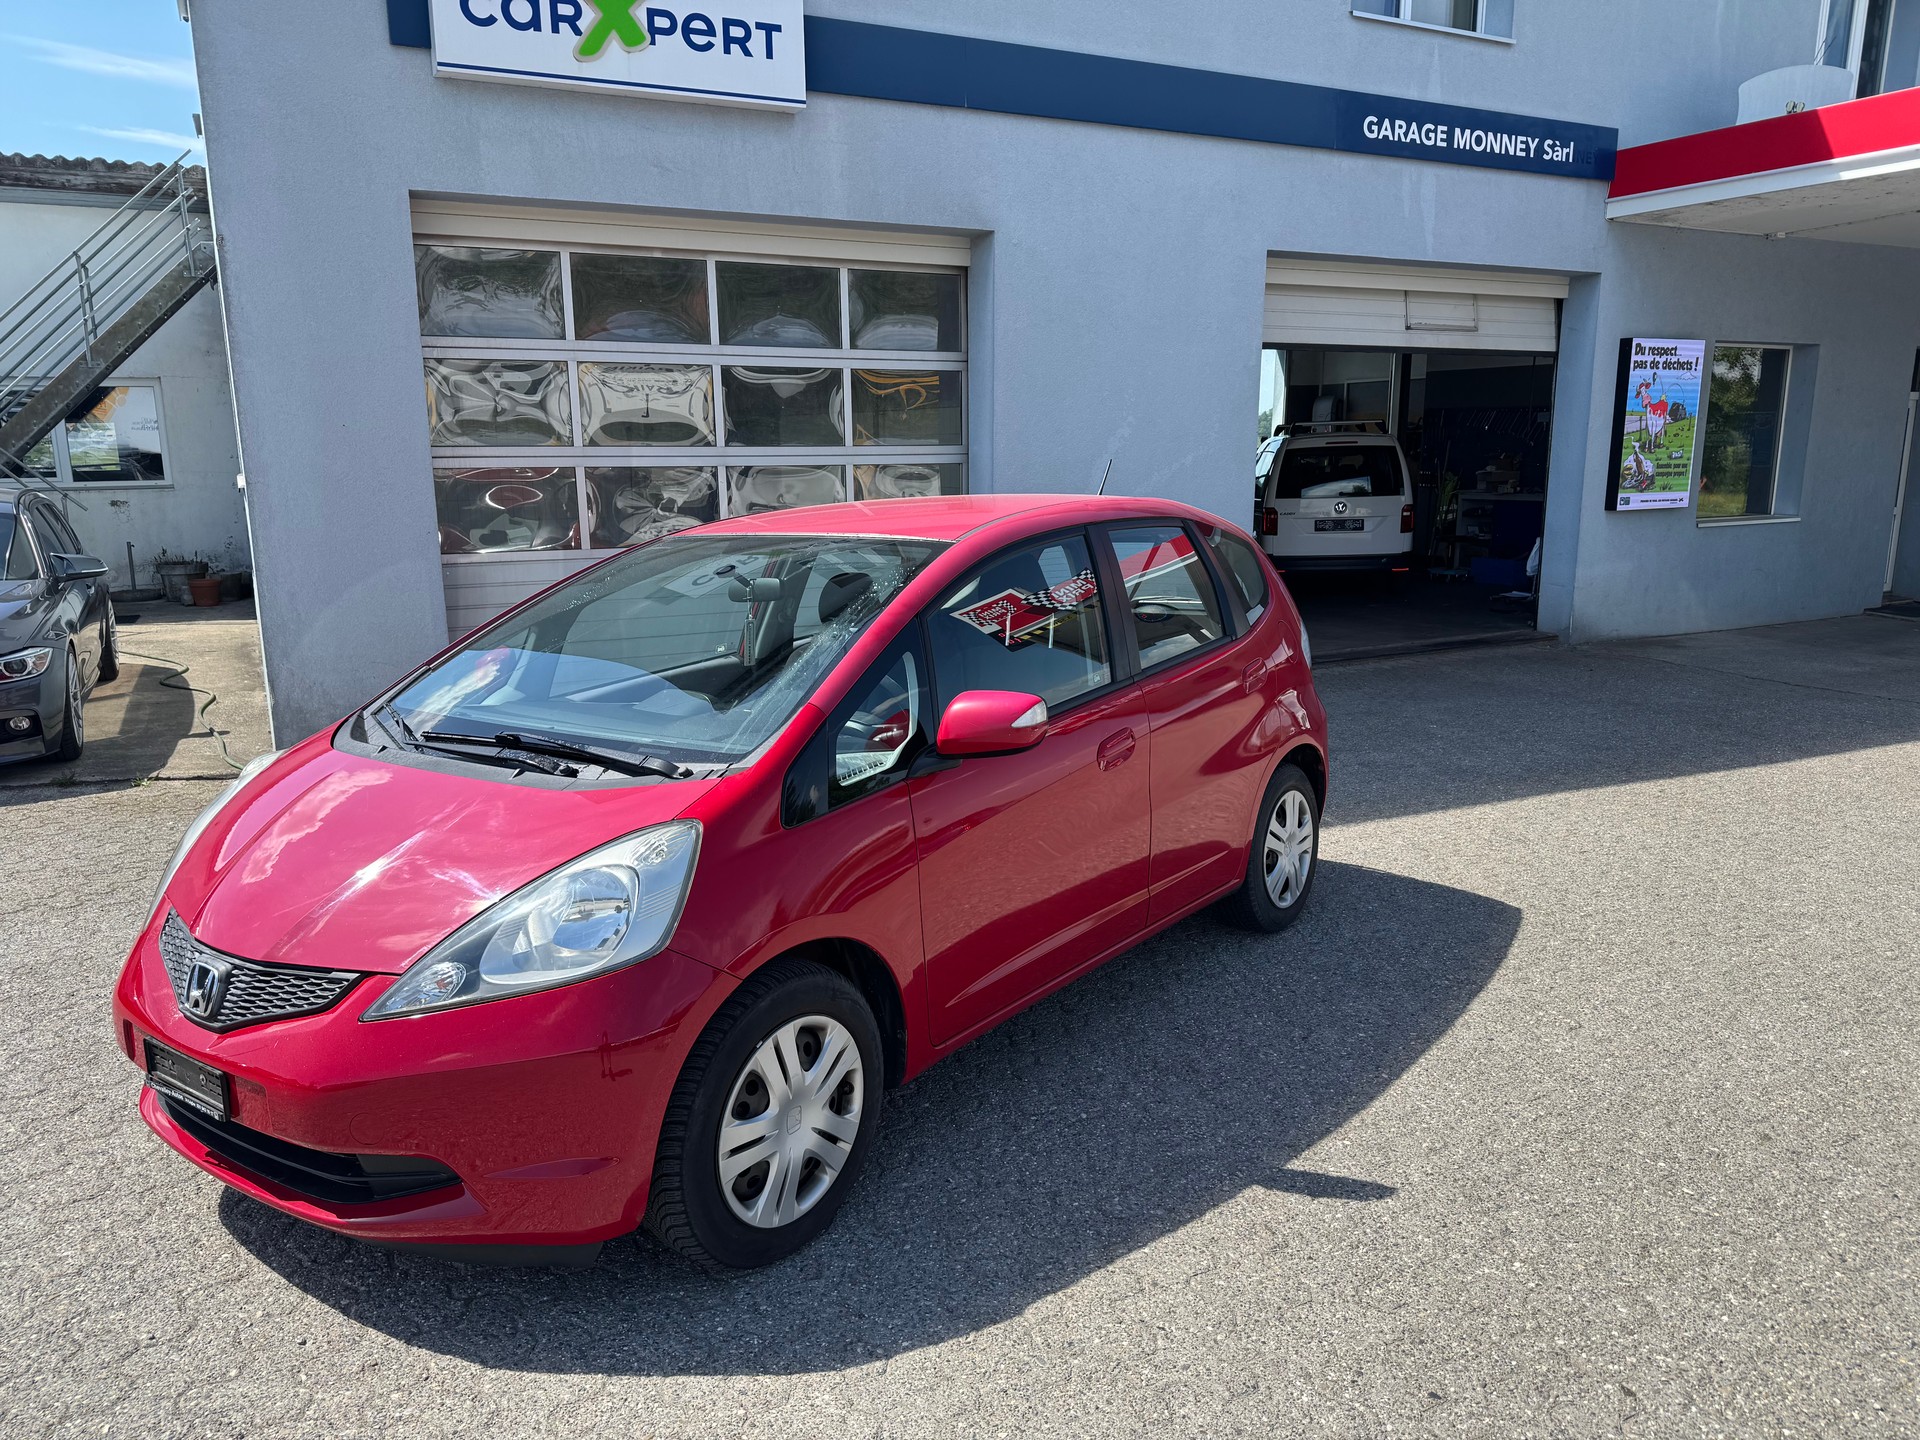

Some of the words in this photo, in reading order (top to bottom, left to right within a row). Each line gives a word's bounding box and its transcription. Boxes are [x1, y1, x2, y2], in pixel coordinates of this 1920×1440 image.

[1363, 115, 1448, 147] GARAGE
[1453, 127, 1540, 158] MONNEY
[1543, 139, 1575, 163] Sàrl
[1634, 343, 1646, 356] Du
[1633, 359, 1648, 372] pas
[1649, 358, 1660, 370] de
[1662, 357, 1693, 371] déchets
